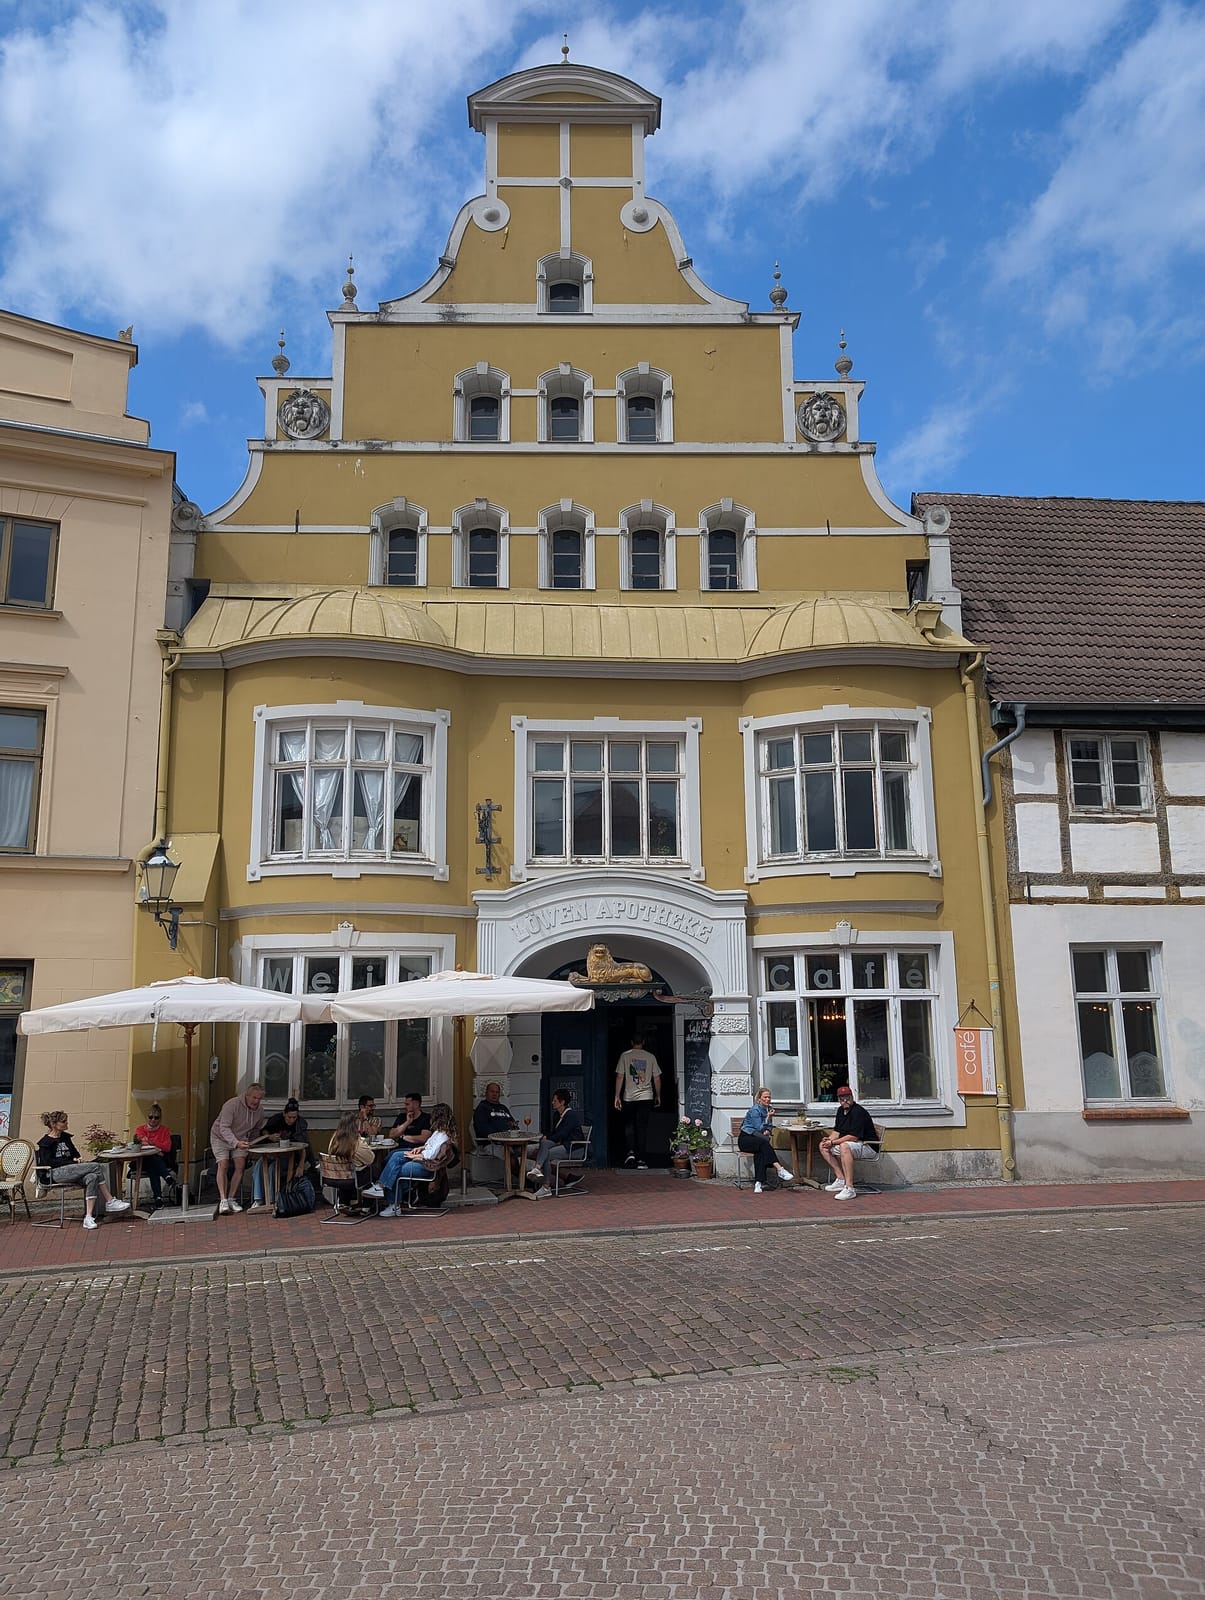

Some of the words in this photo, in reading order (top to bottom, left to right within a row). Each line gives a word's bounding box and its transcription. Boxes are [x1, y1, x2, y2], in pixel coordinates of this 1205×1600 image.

[511, 902, 588, 943] LÖWEN
[595, 897, 714, 944] APOTHEKE
[770, 960, 924, 990] Café
[960, 1031, 976, 1075] café
